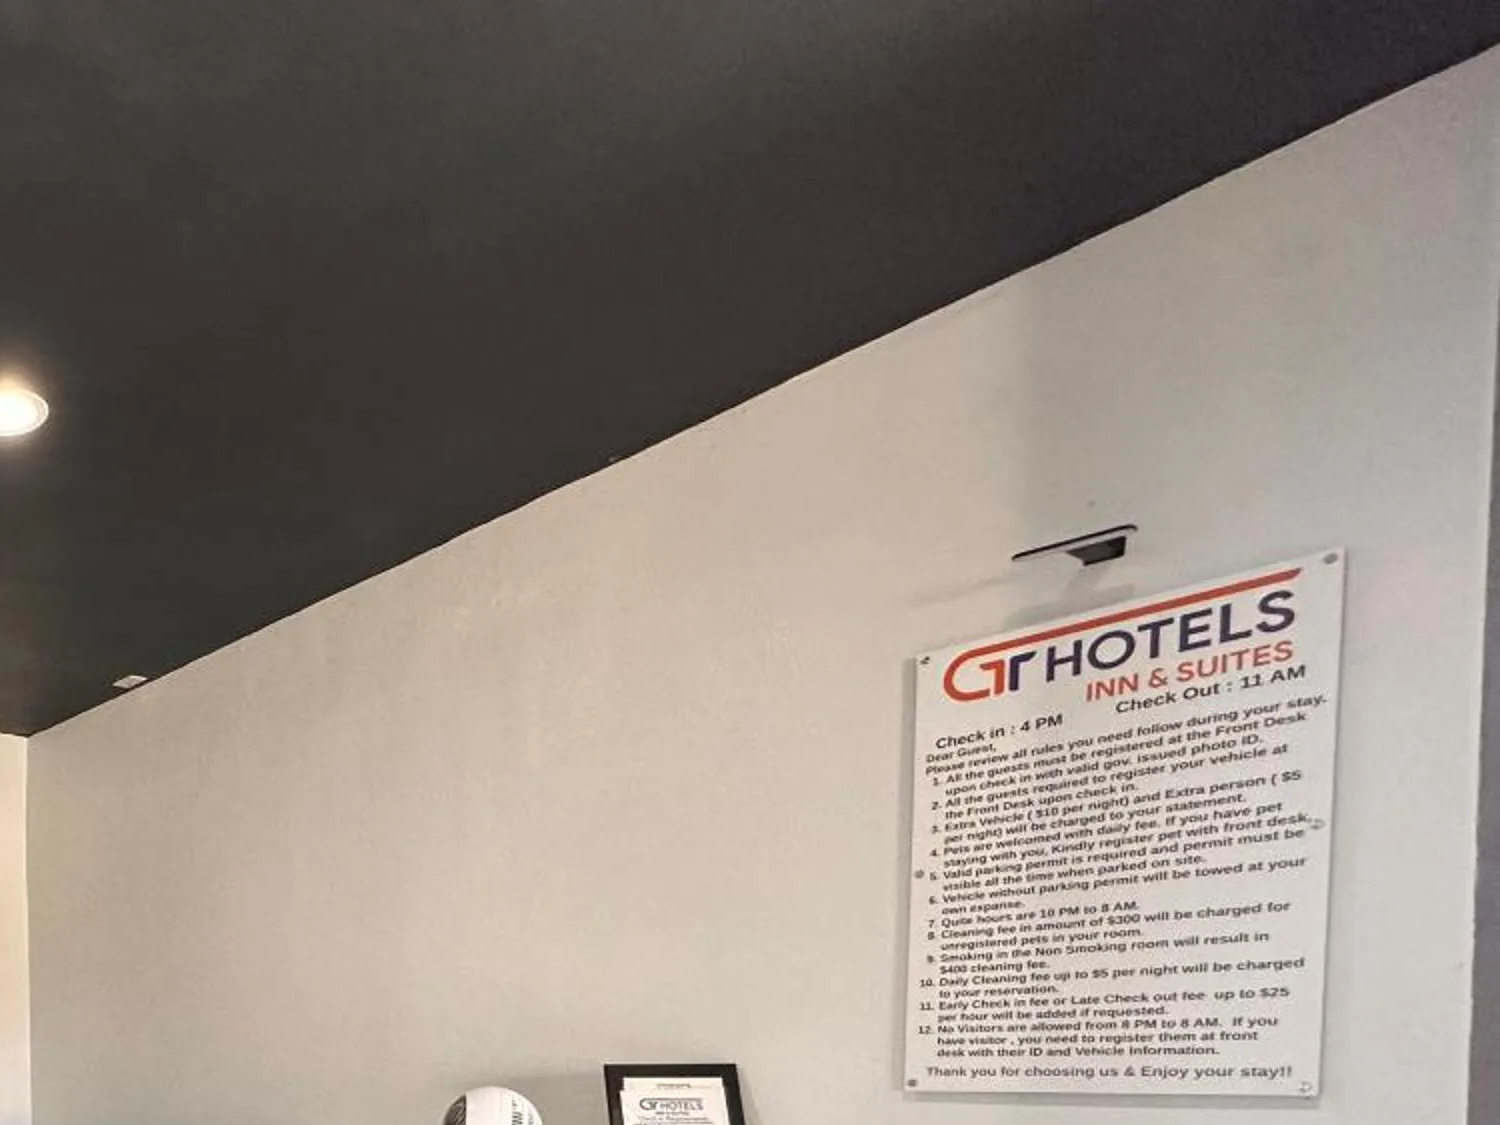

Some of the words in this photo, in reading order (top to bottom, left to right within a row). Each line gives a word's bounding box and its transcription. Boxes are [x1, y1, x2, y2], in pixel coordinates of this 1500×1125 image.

[1045, 589, 1297, 683] HOTELS
[1086, 674, 1139, 702] INN
[1147, 666, 1168, 689] &
[1176, 640, 1295, 684] SUITES
[1116, 693, 1176, 713] Check
[1183, 684, 1220, 700] Out
[1241, 674, 1263, 688] 11
[1271, 665, 1306, 683] AM
[936, 731, 984, 749] Check
[988, 726, 1006, 739] in
[1019, 719, 1031, 732] 4
[1036, 714, 1062, 729] PM
[1136, 720, 1183, 737] follow
[1185, 710, 1239, 728] during
[1242, 702, 1281, 721] your
[1185, 729, 1212, 742] the
[1214, 719, 1260, 737] Front
[1262, 711, 1306, 729] Desk
[1136, 745, 1187, 764] issued
[1190, 738, 1237, 757] photo
[1169, 758, 1205, 774] your
[1208, 747, 1268, 765] vehicle
[1132, 790, 1161, 805] and
[1164, 785, 1206, 800] Extra
[1208, 776, 1267, 796] person
[1126, 804, 1162, 821] your
[1178, 812, 1209, 827] you
[1212, 806, 1252, 821] have
[1255, 801, 1283, 817] pet
[1149, 841, 1179, 855] and
[1182, 836, 1234, 855] permit
[1236, 830, 1280, 845] must
[1156, 828, 1183, 844] pet
[1184, 823, 1219, 838] with
[1222, 818, 1263, 833] front
[1141, 869, 1169, 884] will
[1194, 862, 1244, 877] towed
[1267, 857, 1306, 873] your
[1143, 910, 1170, 923] will
[1195, 902, 1263, 919] charged
[1266, 900, 1291, 913] for
[1130, 938, 1169, 951] room
[1172, 934, 1200, 948] will
[1202, 931, 1250, 945] result
[1138, 964, 1179, 978] night
[1180, 961, 1209, 974] will
[1235, 956, 1305, 972] charged
[1151, 991, 1178, 1004] out
[1181, 990, 1206, 1001] fee
[1259, 986, 1290, 999] $25
[1246, 1016, 1278, 1029] you
[1157, 1031, 1197, 1043] them
[1218, 1029, 1259, 1041] front
[1140, 1065, 1190, 1079] Enjoy
[1193, 1067, 1235, 1080] your
